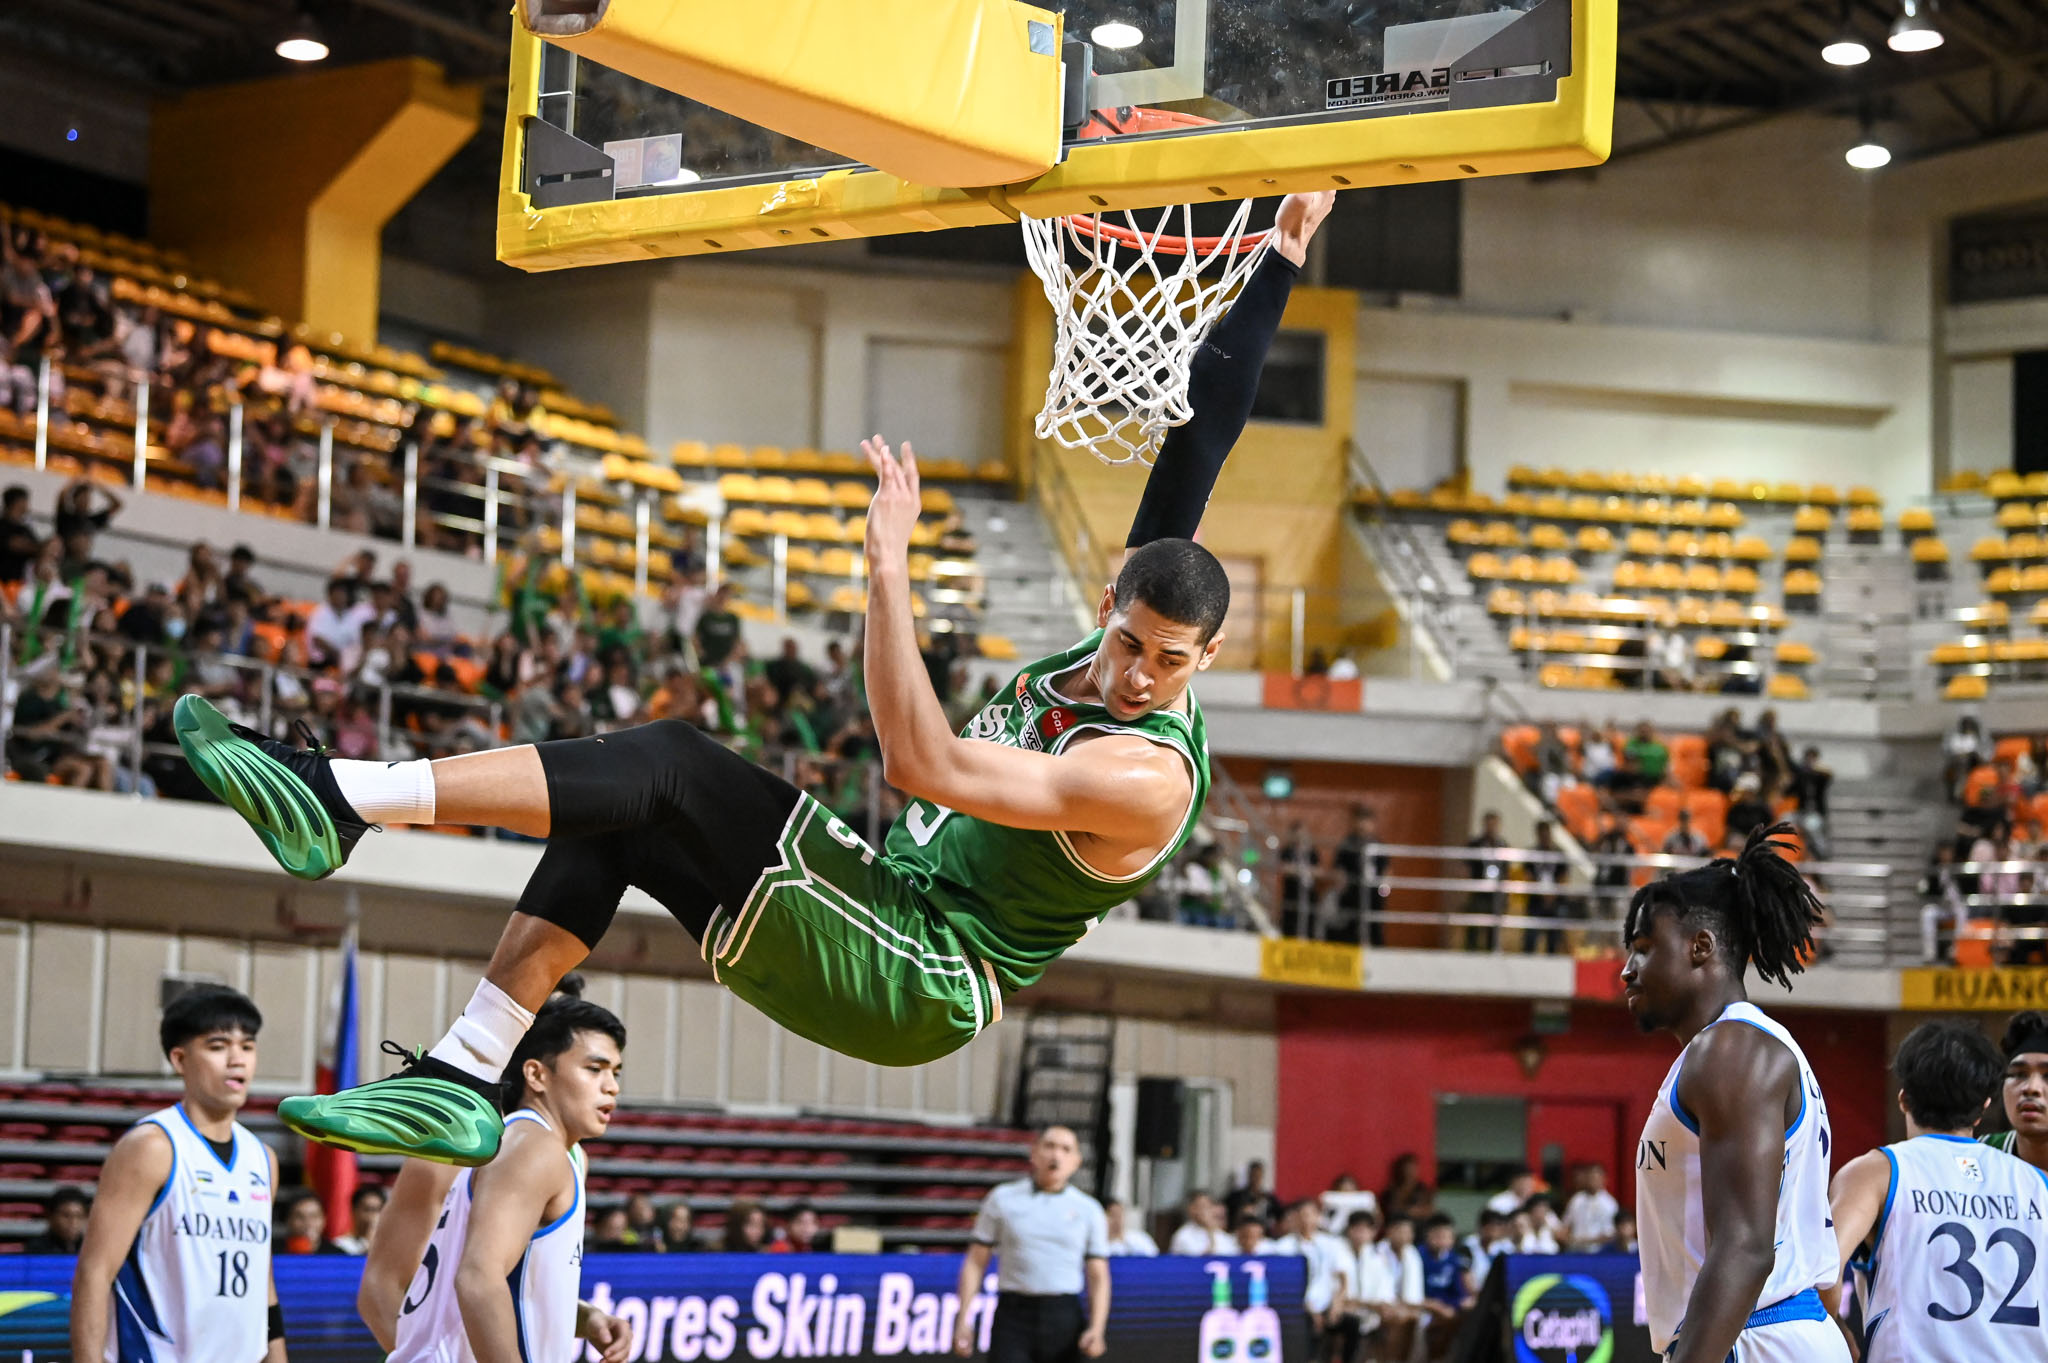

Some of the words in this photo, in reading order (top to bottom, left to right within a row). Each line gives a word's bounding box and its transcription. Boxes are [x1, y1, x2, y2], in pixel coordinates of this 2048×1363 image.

[1911, 1189, 2018, 1220] RONZONE
[215, 1249, 249, 1299] 18
[1927, 1221, 2041, 1328] 32
[573, 1281, 740, 1363] tores
[747, 1272, 866, 1359] Skin
